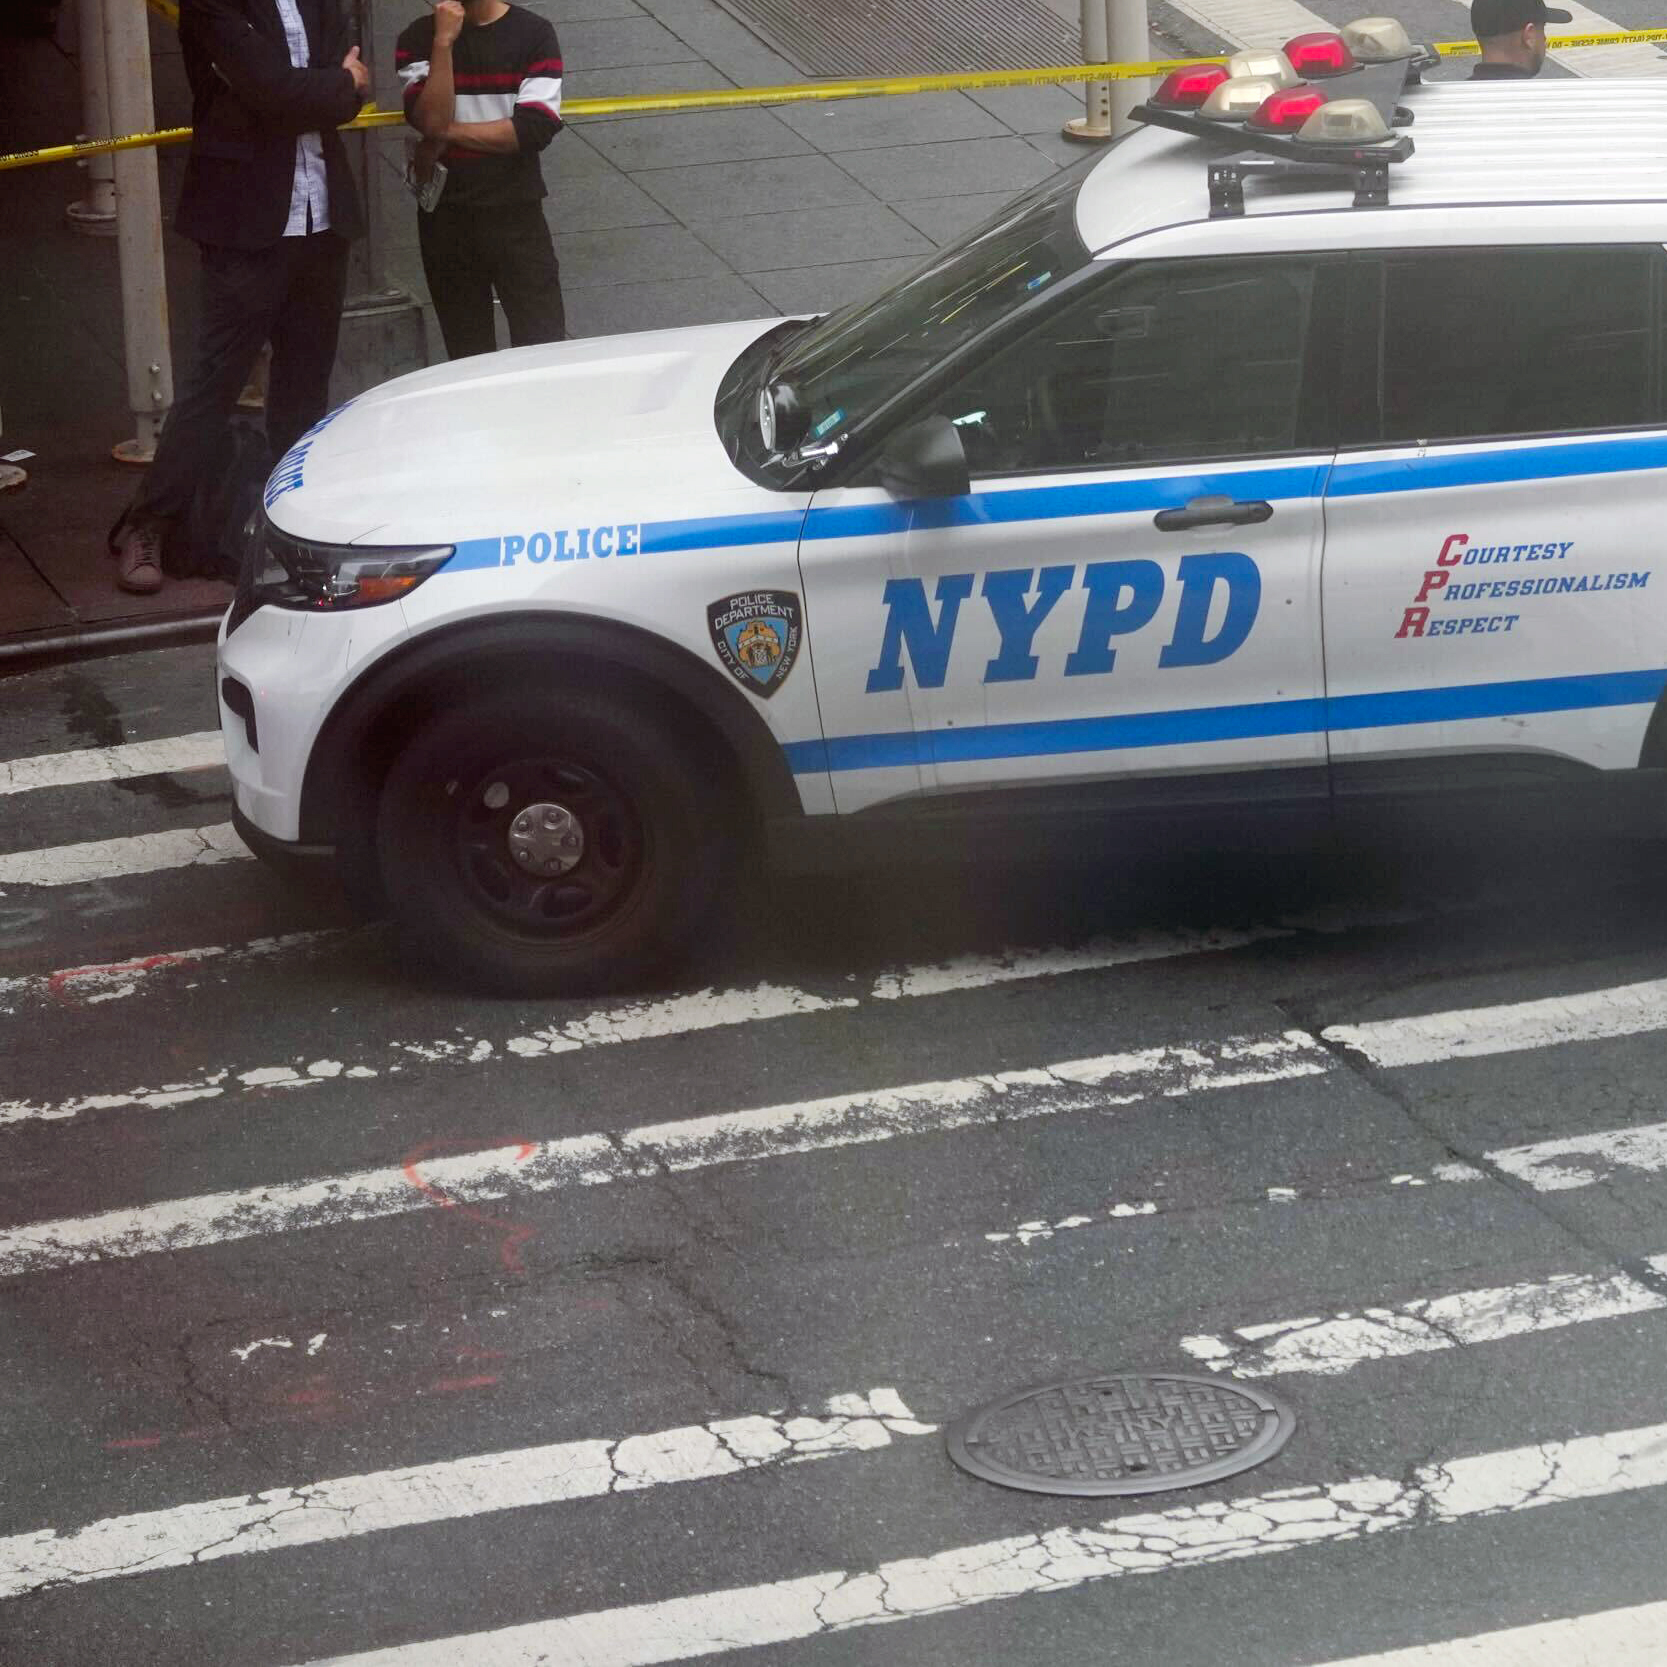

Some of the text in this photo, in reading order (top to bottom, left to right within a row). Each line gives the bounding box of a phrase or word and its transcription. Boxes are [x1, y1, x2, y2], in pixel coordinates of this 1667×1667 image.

[502, 525, 639, 567] POLICE
[1436, 533, 1574, 567] COURTESY
[729, 594, 775, 610] POLICE
[1414, 570, 1652, 603] PROFESSIONALISM
[714, 605, 794, 631] DEPARTMENT
[865, 551, 1262, 694] NYPD
[1394, 606, 1520, 639] RESPECT
[717, 640, 750, 680] CITY OF
[775, 625, 798, 679] NEW YORK
